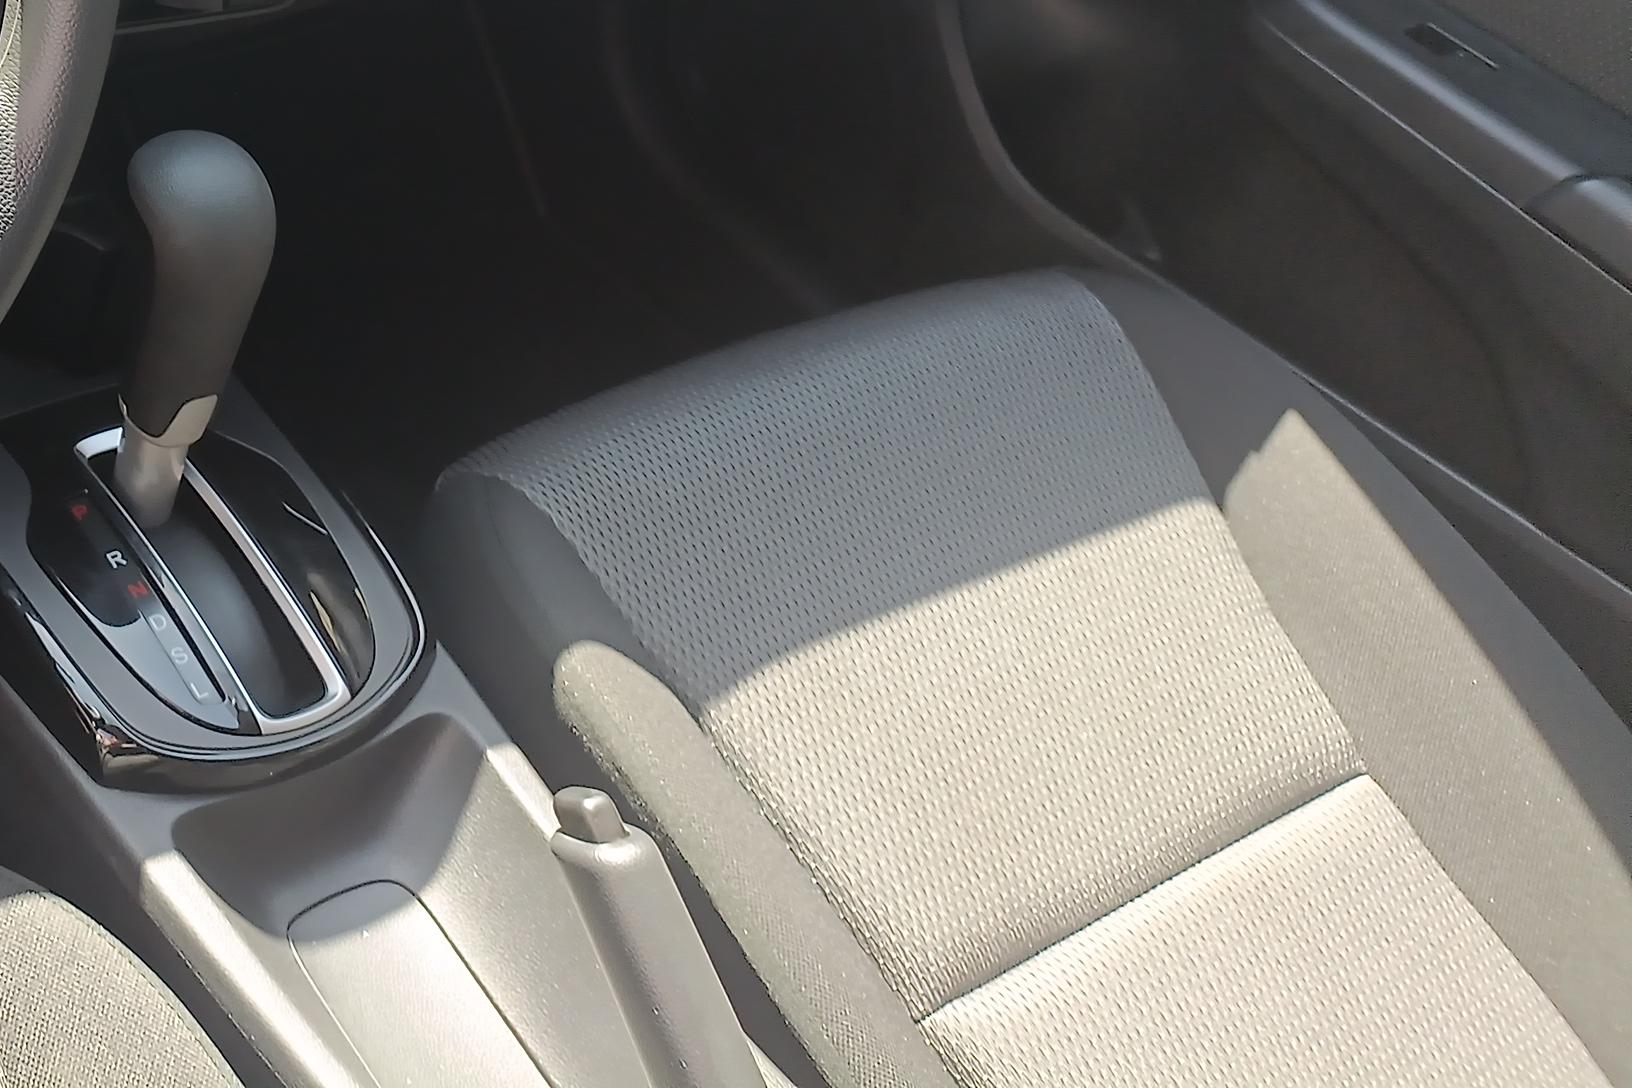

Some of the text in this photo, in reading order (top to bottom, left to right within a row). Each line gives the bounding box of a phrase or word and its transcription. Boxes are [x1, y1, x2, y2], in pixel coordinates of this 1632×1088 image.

[106, 550, 127, 569] R
[128, 580, 149, 598] N
[149, 614, 167, 631] D
[171, 646, 188, 663] S
[190, 682, 209, 699] L
